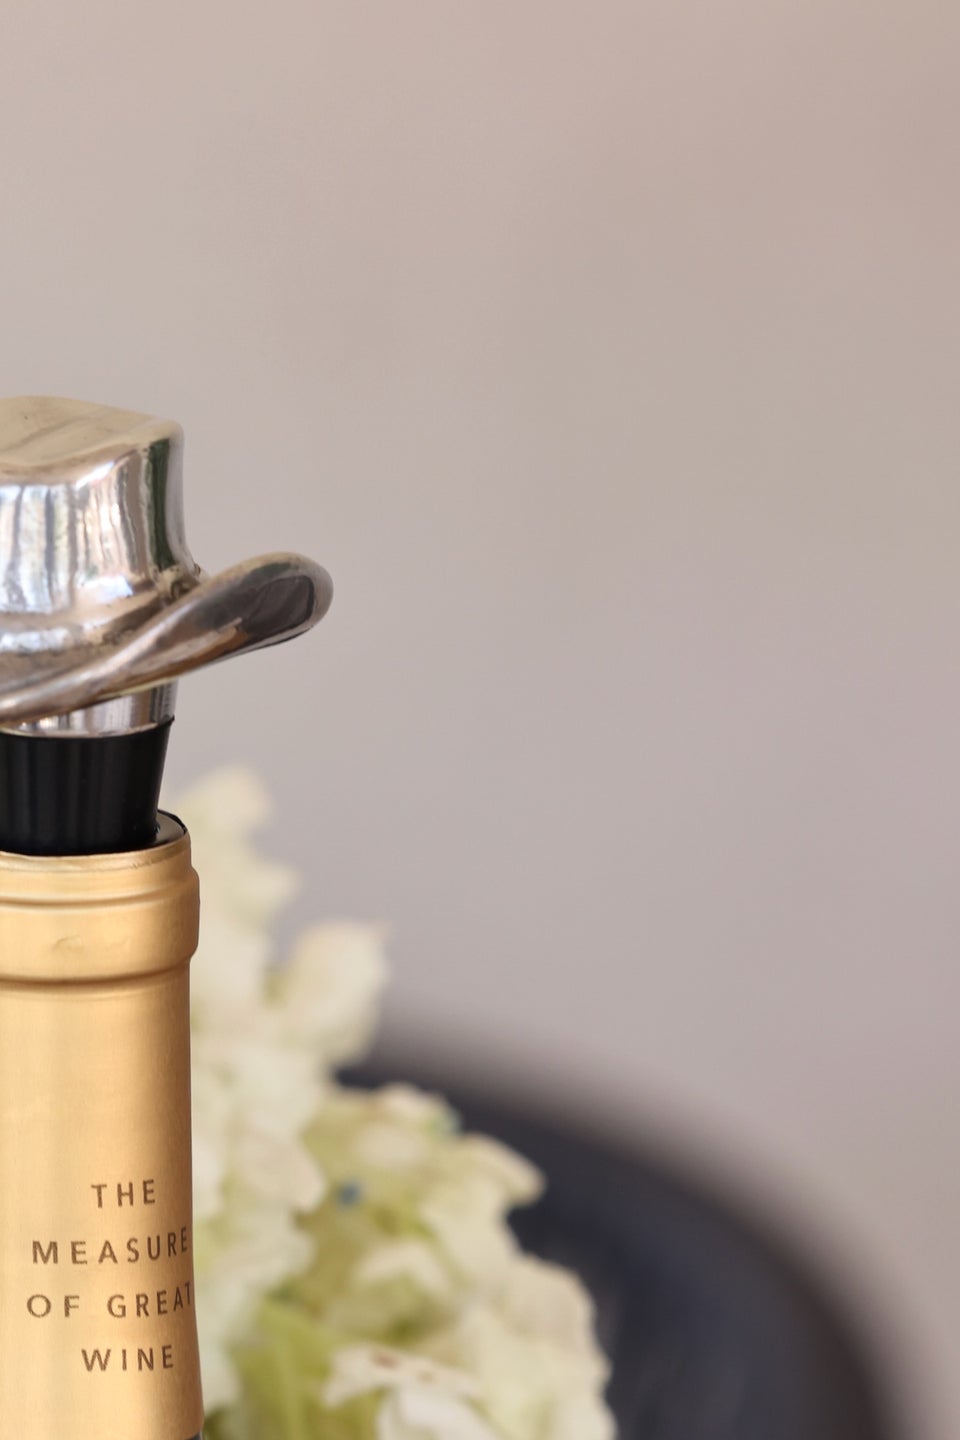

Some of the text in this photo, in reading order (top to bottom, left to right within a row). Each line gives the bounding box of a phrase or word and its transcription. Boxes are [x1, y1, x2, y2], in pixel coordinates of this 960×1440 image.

[91, 1179, 156, 1208] THE
[32, 1226, 188, 1264] MEASURE
[26, 1282, 191, 1318] OF GREAT
[81, 1345, 174, 1372] WINE
